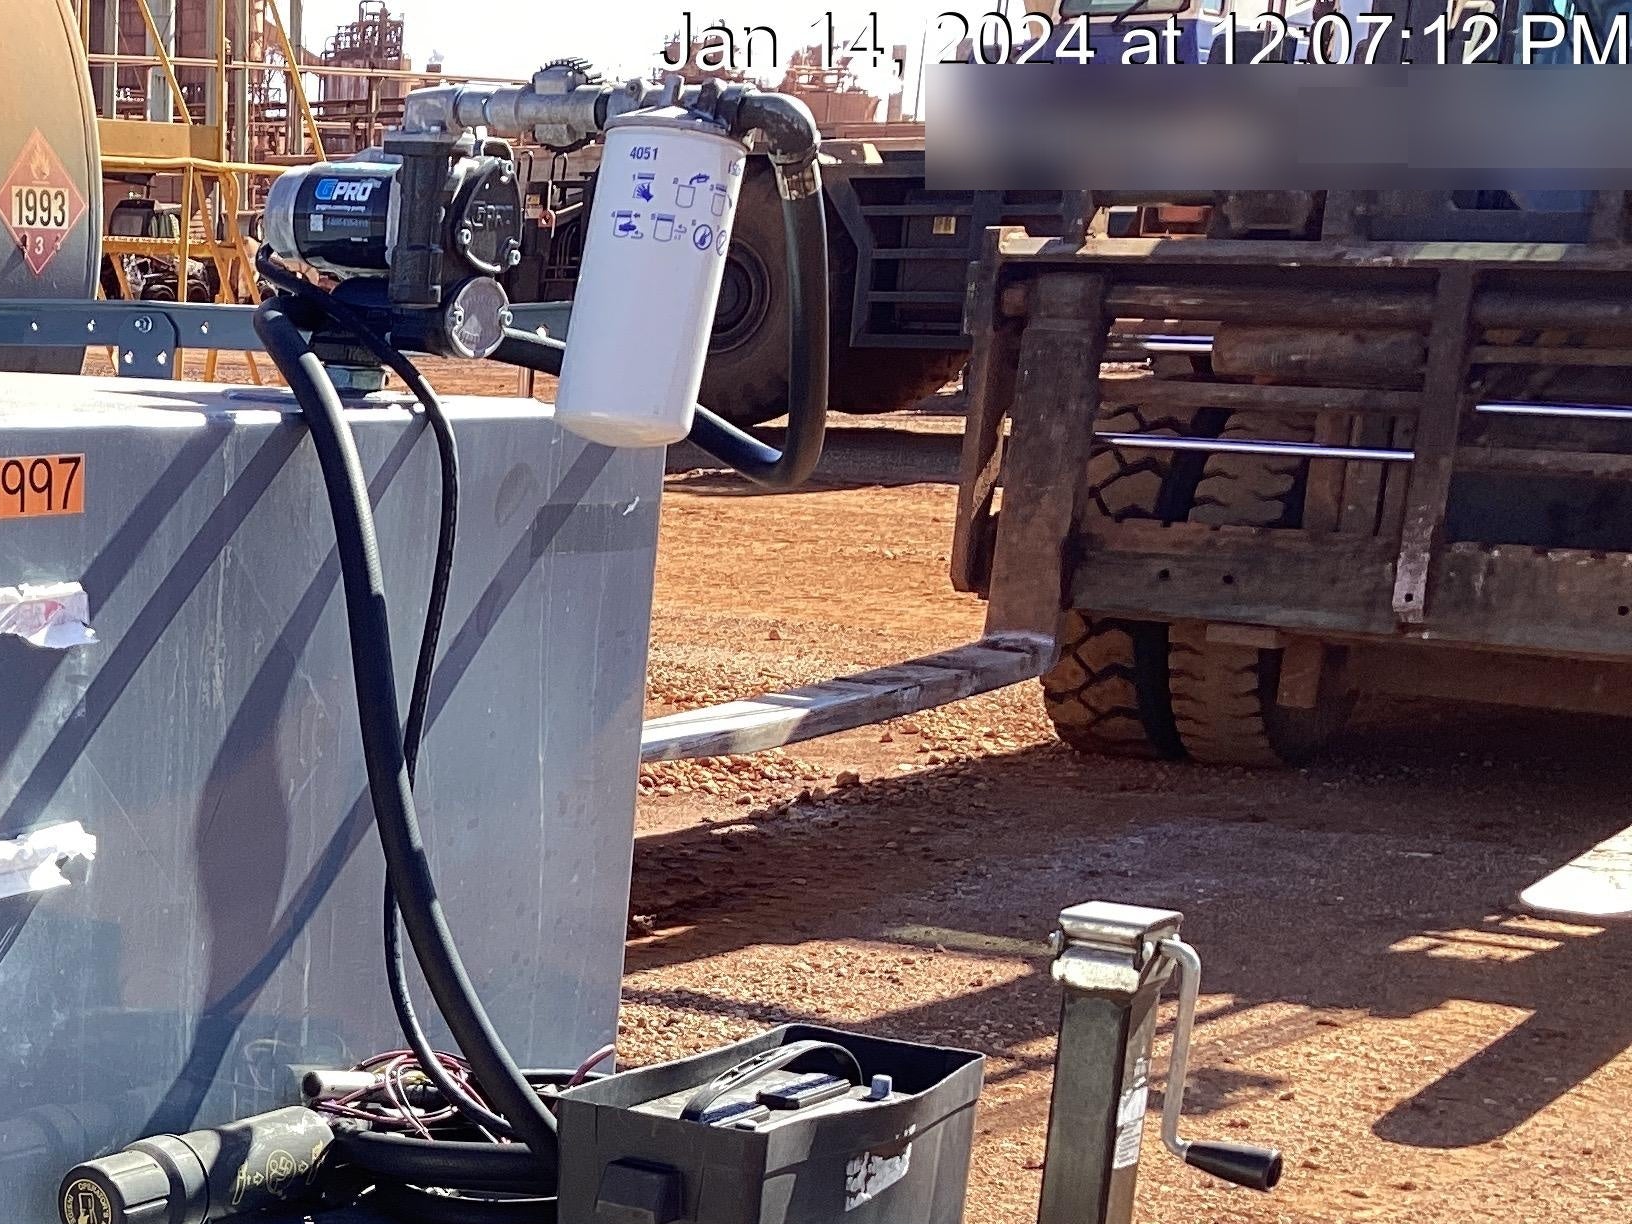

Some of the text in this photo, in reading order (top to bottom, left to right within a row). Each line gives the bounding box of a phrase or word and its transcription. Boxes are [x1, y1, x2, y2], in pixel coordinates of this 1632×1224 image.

[629, 146, 659, 161] 4051
[14, 187, 67, 228] 1993
[34, 236, 44, 255] 3
